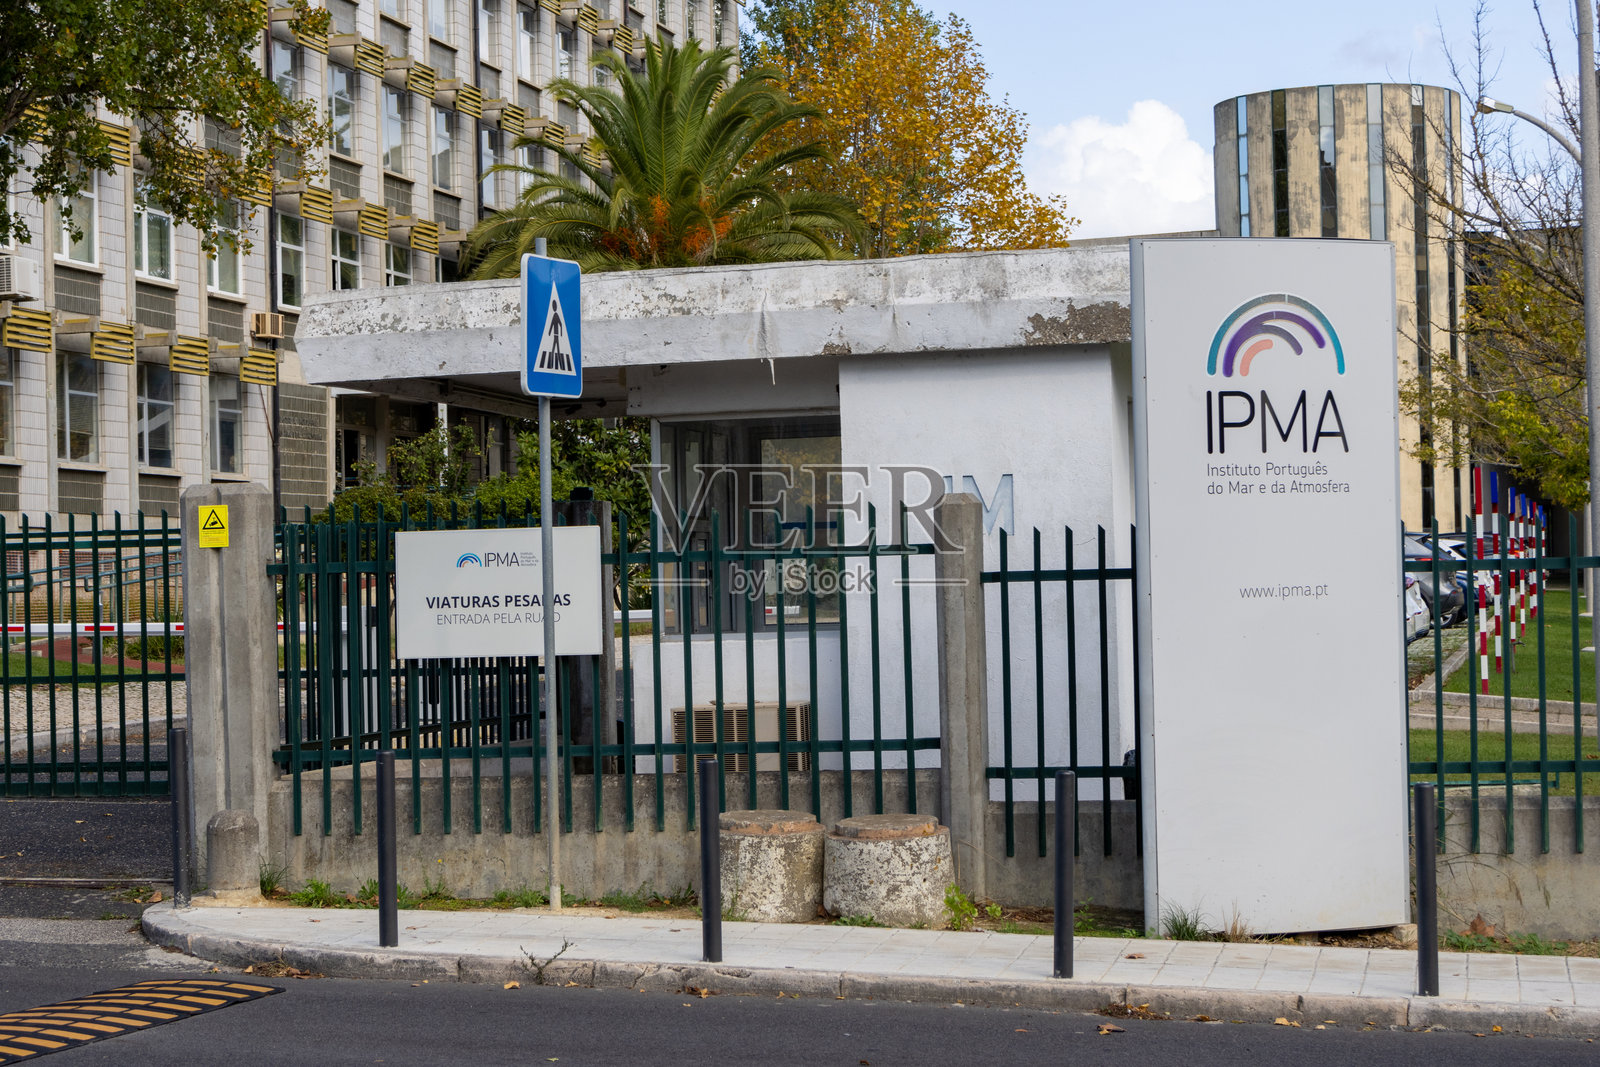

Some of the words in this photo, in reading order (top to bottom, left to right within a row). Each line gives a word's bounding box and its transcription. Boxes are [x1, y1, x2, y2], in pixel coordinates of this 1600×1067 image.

[1206, 389, 1349, 454] IPMA
[1207, 463, 1261, 477] Instituto
[1265, 461, 1328, 479] Português
[1207, 481, 1224, 495] do
[1228, 481, 1254, 495] Mar
[1259, 484, 1266, 494] e
[1271, 480, 1286, 494] da
[1290, 479, 1350, 494] Atmosfera
[484, 551, 520, 567] IPMA
[1239, 584, 1329, 600] www.ipma.pt
[426, 595, 500, 609] VIATURAS
[504, 594, 571, 608] PESAAS
[437, 613, 490, 625] ENTRADA
[493, 612, 522, 624] PELA
